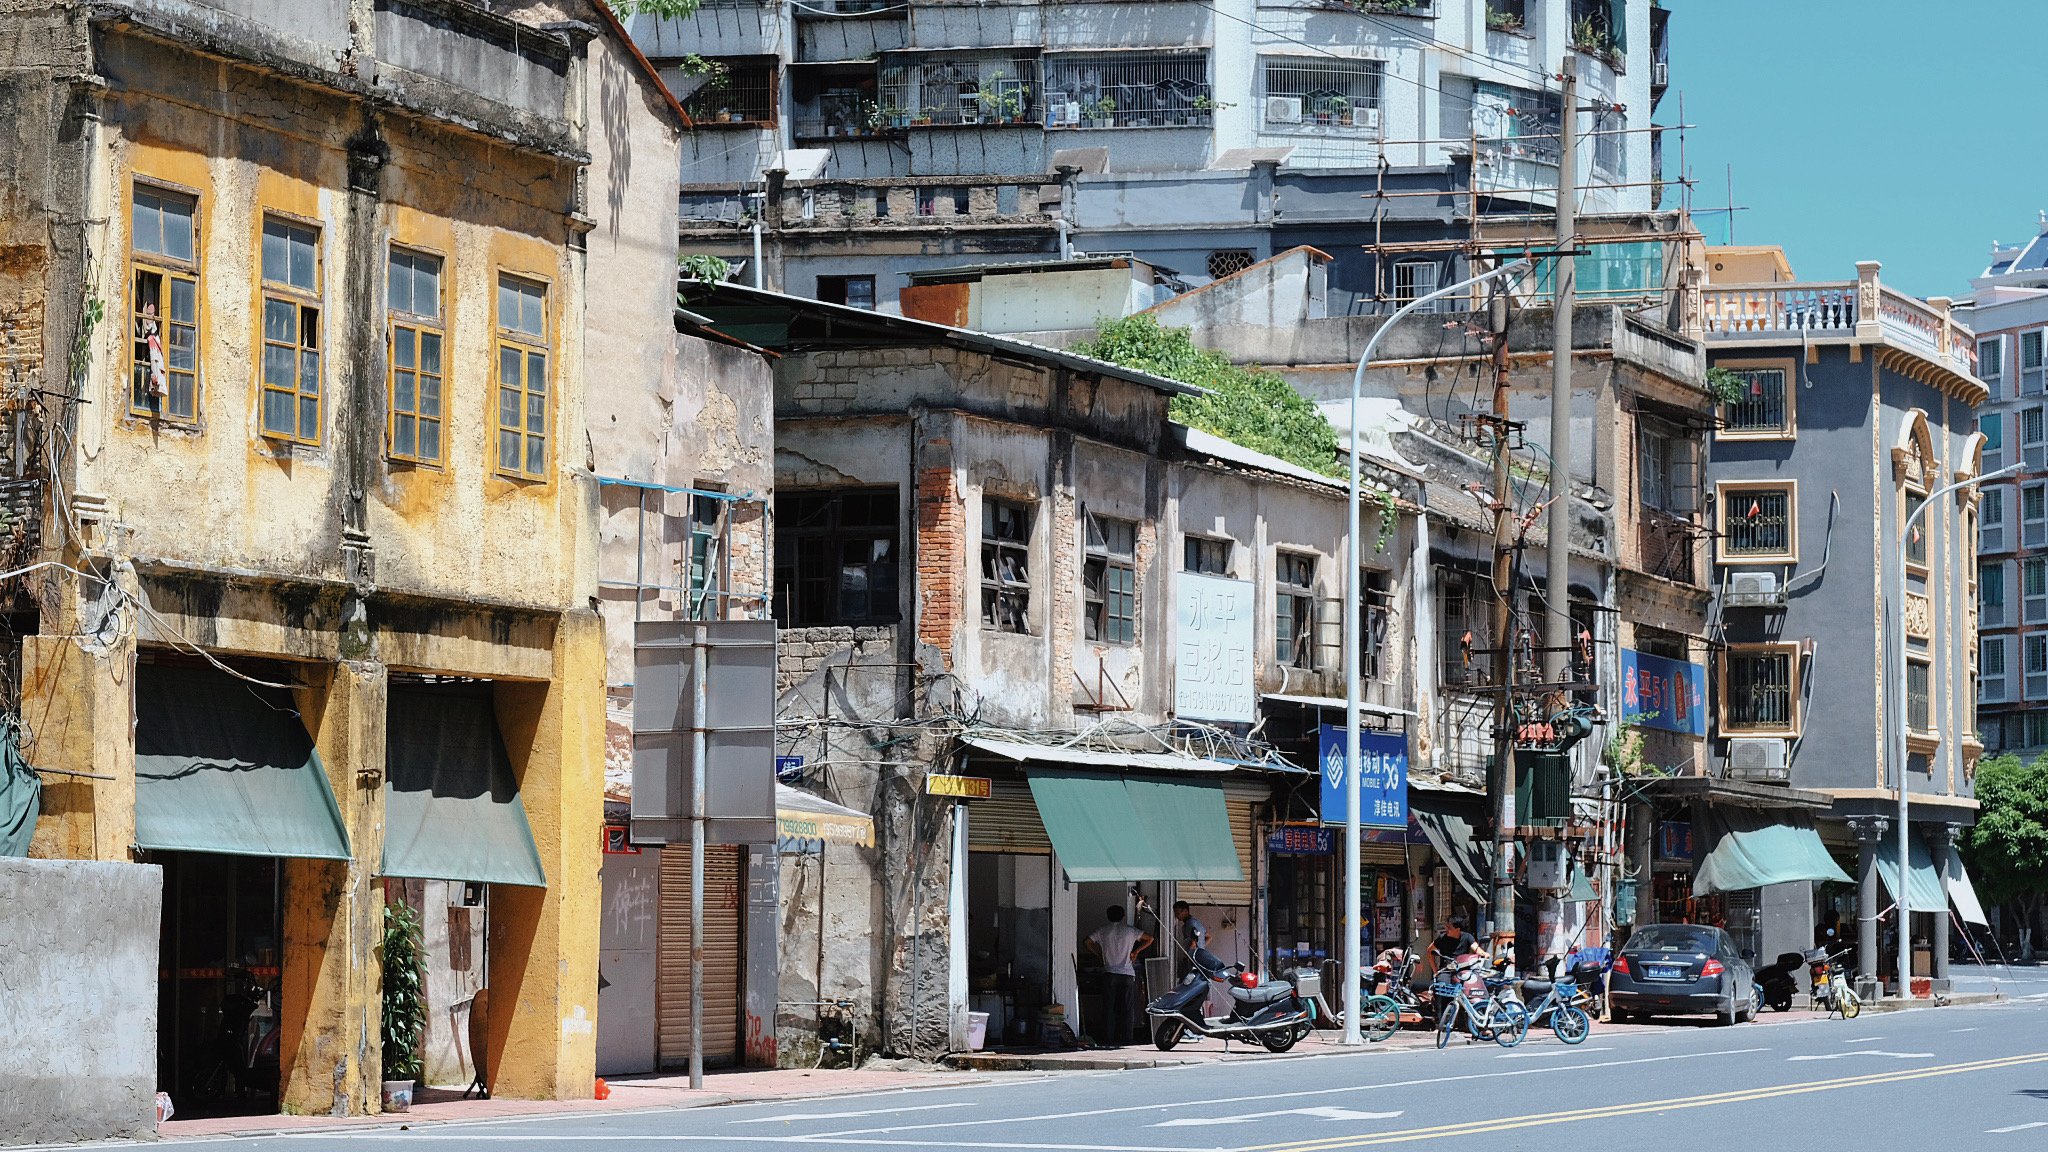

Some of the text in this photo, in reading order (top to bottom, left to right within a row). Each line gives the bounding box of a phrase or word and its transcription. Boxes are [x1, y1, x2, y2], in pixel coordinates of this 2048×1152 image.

[1190, 588, 1236, 634] 永平
[1182, 638, 1244, 685] 豆浆店
